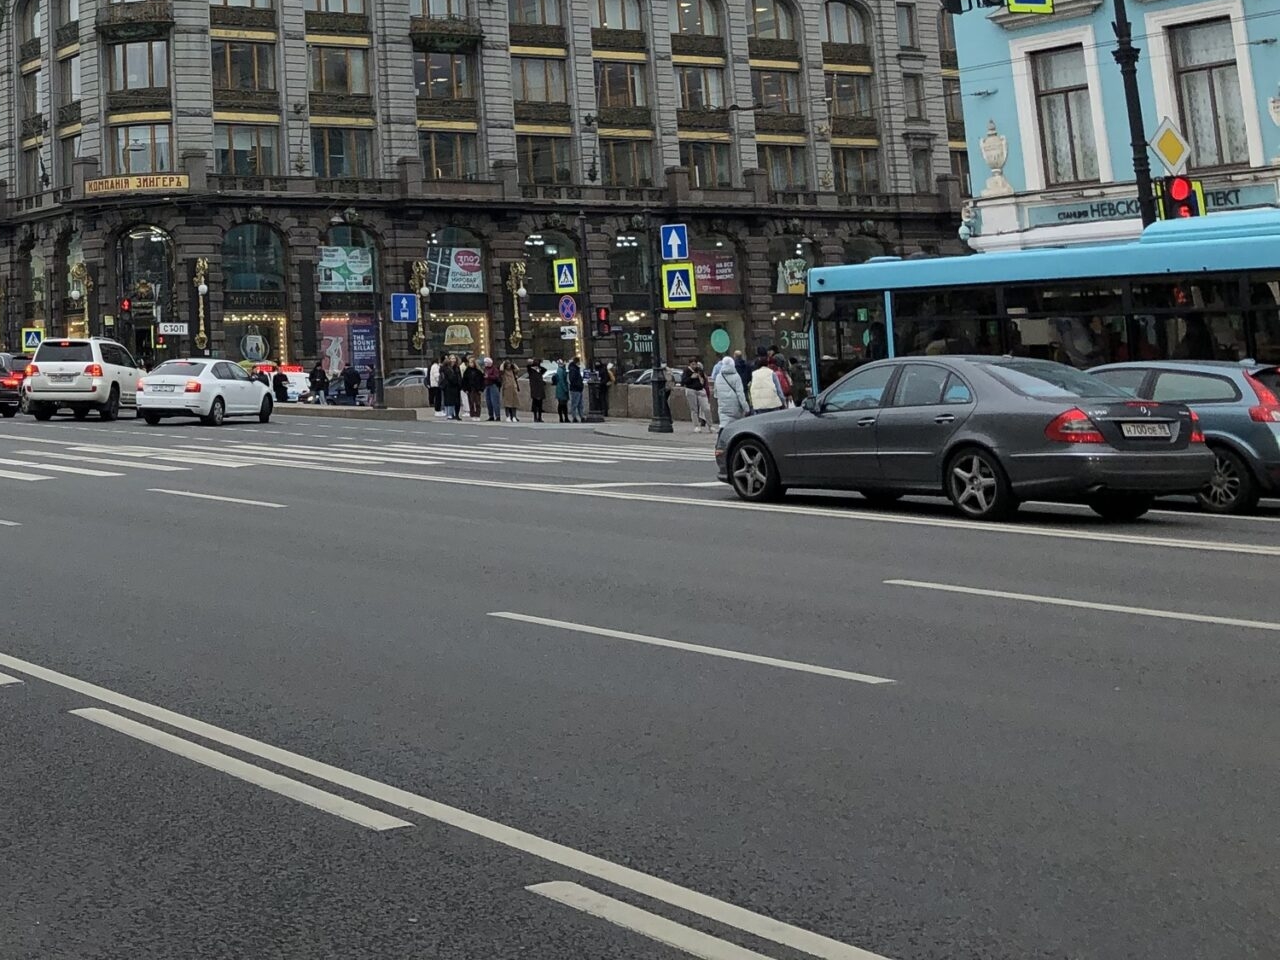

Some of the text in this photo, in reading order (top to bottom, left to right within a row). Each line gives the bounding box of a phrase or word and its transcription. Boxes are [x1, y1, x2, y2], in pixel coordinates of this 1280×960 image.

[1205, 189, 1241, 207] ПЕКТ
[623, 332, 633, 353] 3
[780, 330, 790, 350] 3
